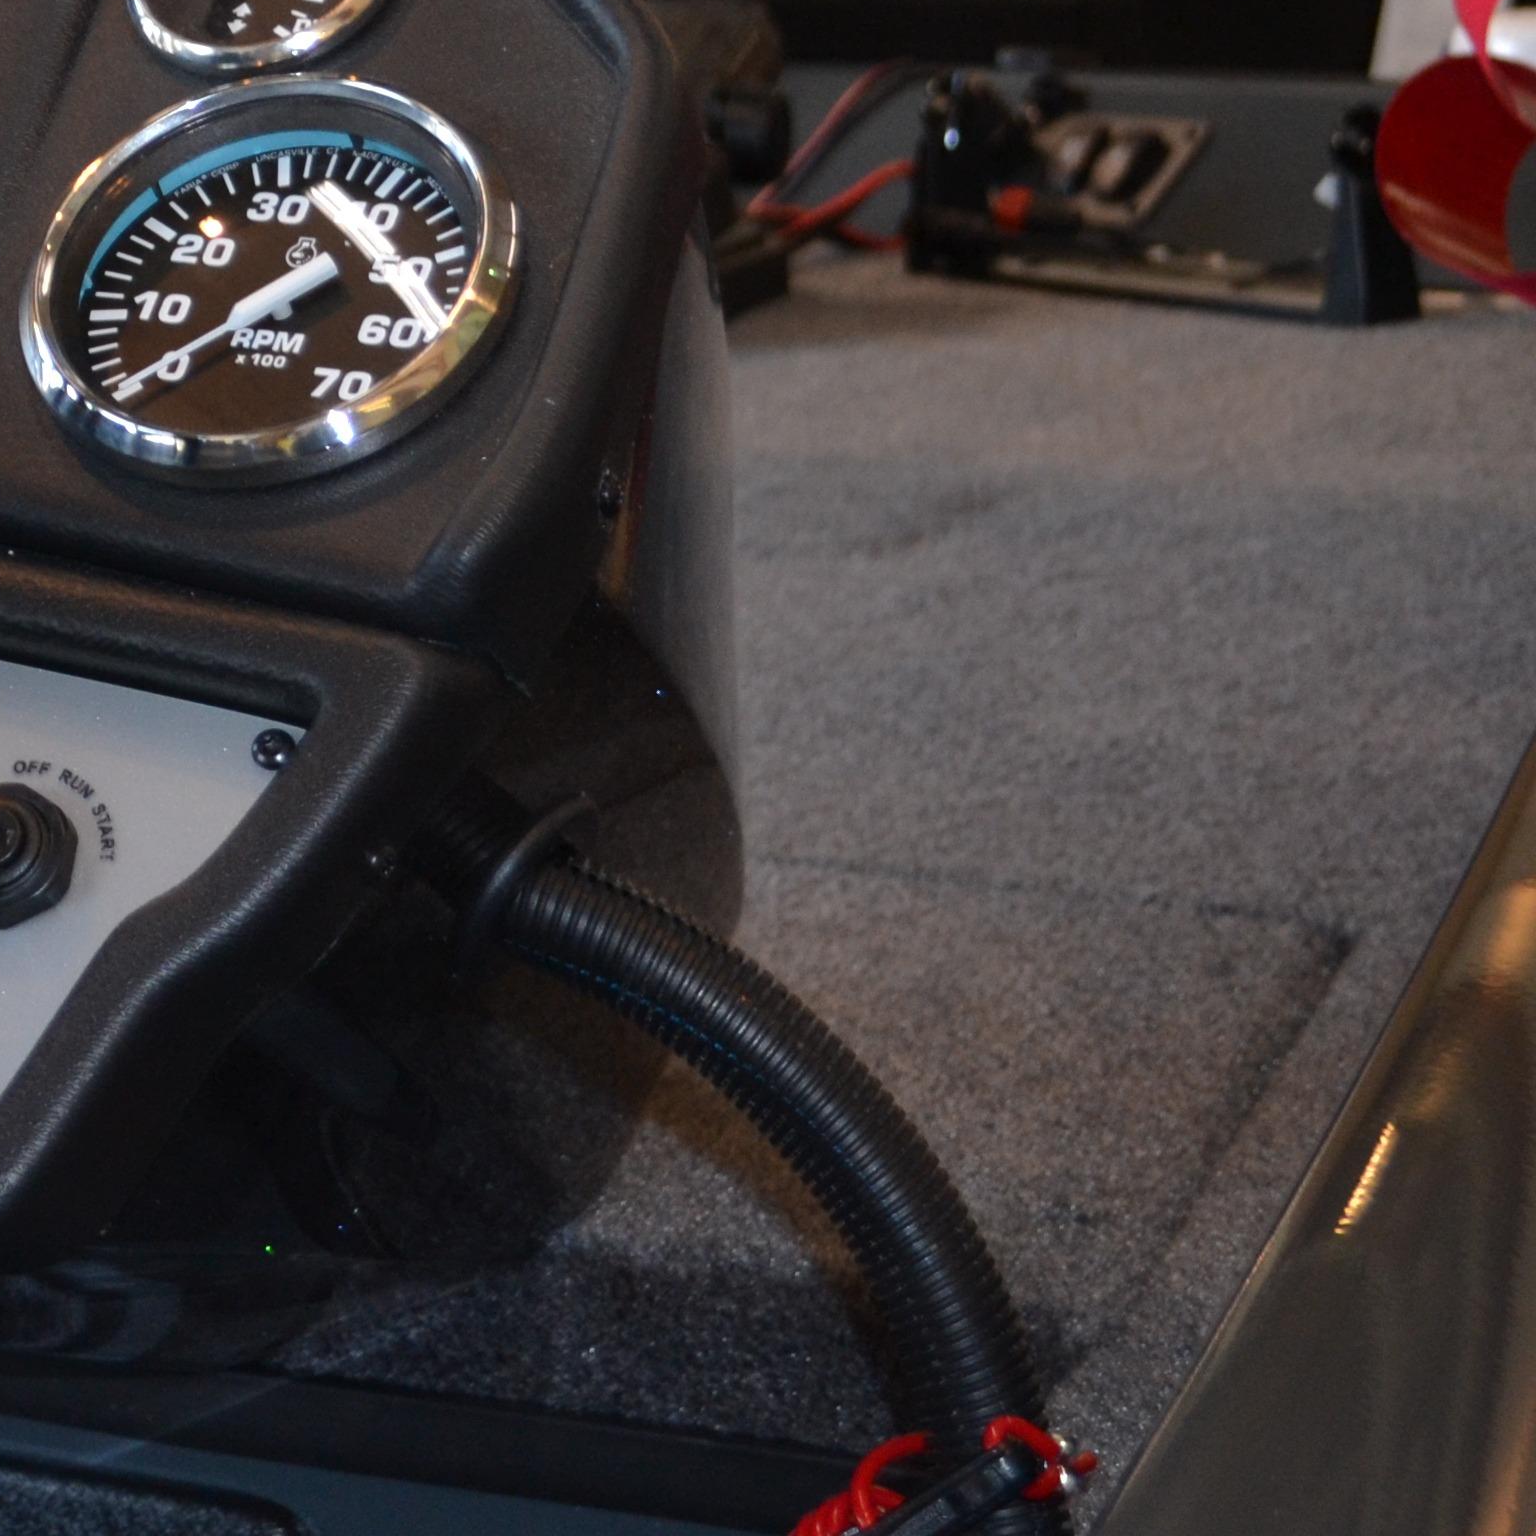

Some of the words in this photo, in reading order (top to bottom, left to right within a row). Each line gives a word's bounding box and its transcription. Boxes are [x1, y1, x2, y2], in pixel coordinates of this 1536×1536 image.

[246, 192, 310, 224] 30
[170, 234, 235, 267] 20
[134, 291, 191, 324] 10
[230, 328, 304, 353] RPM
[357, 314, 424, 348] 60
[154, 351, 190, 381] 0
[251, 353, 286, 368] 100
[310, 367, 373, 401] 70
[13, 760, 51, 774] OFF
[58, 768, 95, 799] RUN
[91, 803, 115, 862] START
